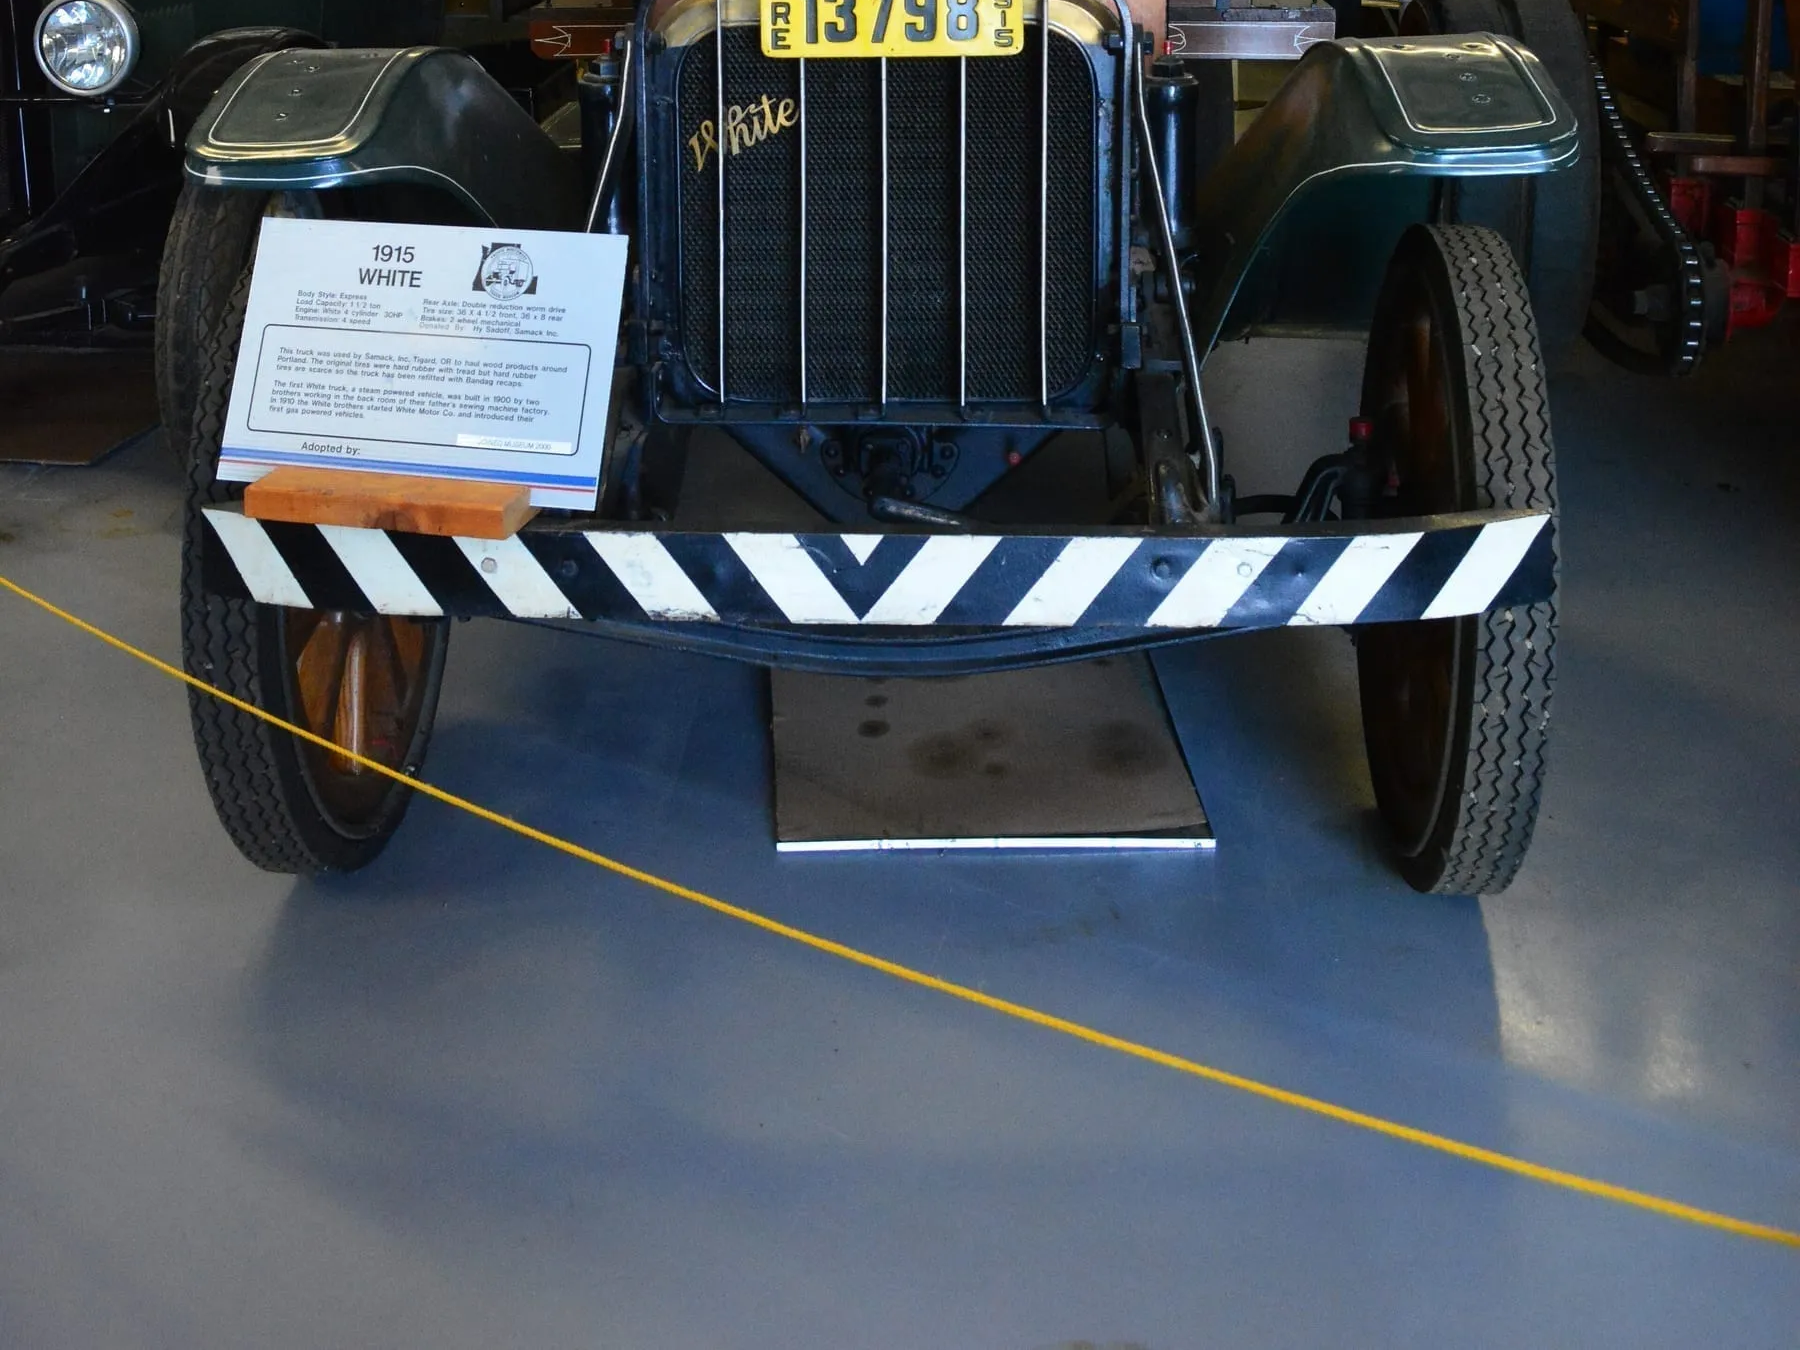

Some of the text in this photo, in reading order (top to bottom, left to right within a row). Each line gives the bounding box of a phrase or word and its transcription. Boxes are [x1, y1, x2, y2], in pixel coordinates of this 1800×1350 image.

[372, 243, 416, 263] 1915
[358, 267, 423, 288] WHITE
[297, 289, 315, 298] Body
[300, 441, 361, 456] Adopted by:
